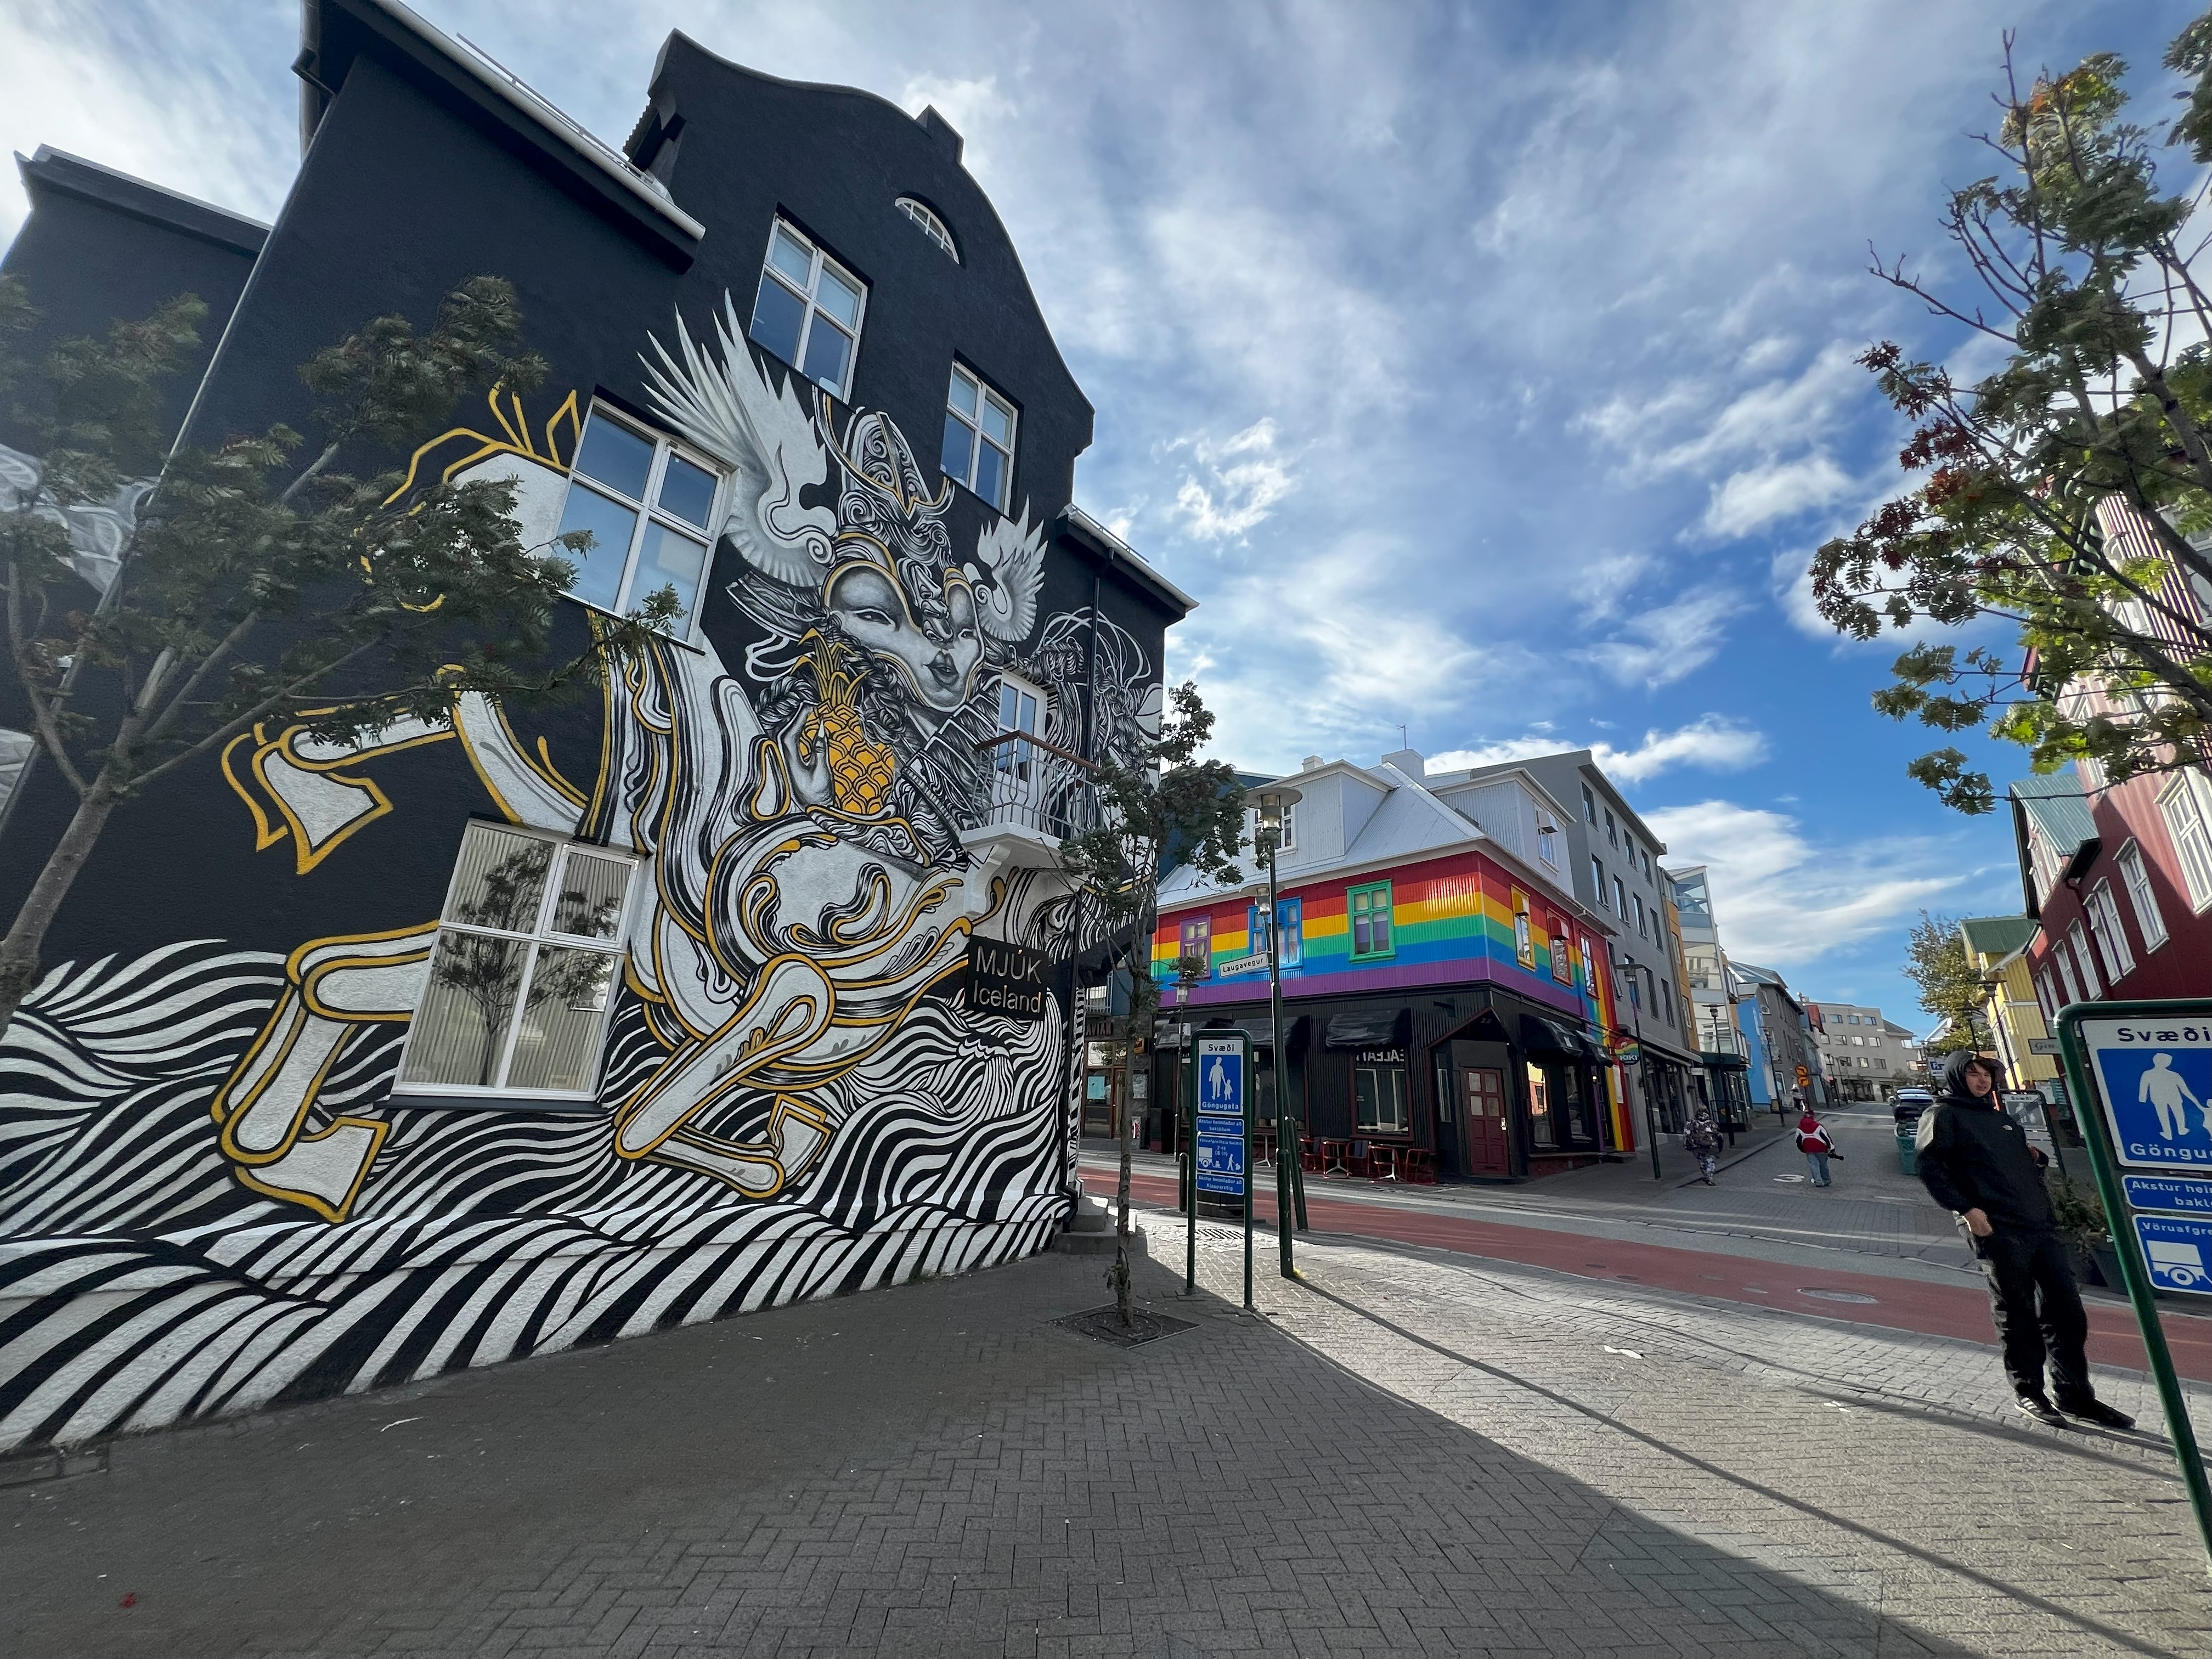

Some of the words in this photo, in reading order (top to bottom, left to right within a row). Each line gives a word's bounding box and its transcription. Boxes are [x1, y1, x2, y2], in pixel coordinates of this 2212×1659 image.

[976, 946, 1041, 984] MJÚK
[1223, 958, 1263, 973] Laugavegur
[973, 980, 1041, 1013] Iceland
[2117, 1026, 2211, 1042] Svæði
[1208, 1043, 1234, 1052] Svæði
[1202, 1101, 1239, 1110] Göngugata
[2132, 1181, 2181, 1192] Akstur
